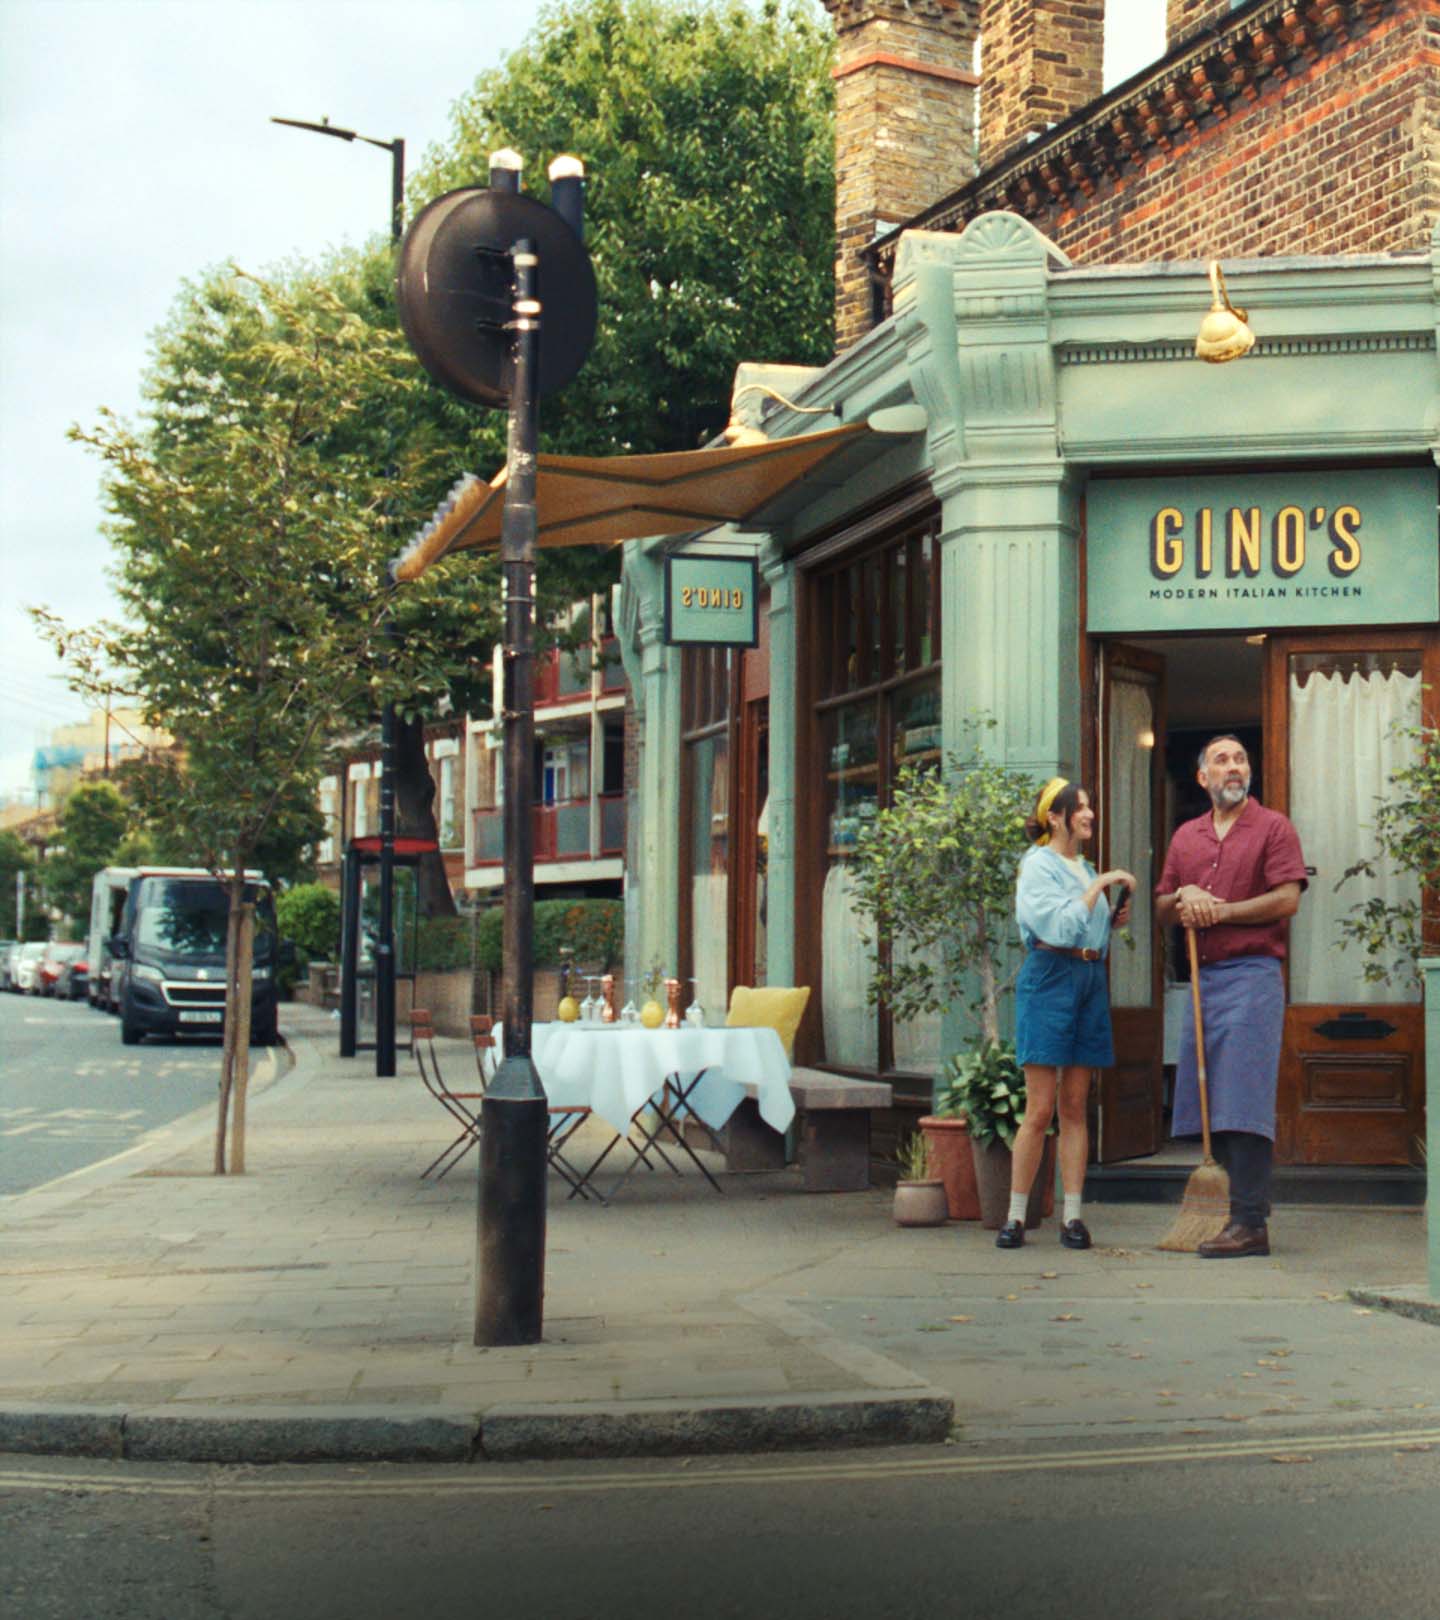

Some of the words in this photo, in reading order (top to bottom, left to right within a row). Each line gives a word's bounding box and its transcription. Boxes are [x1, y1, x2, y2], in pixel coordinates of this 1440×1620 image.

[1150, 504, 1362, 581] GINO'S
[1150, 588, 1218, 600] MODERN
[1226, 587, 1287, 599] ITALIAN
[1295, 586, 1362, 598] KITCHEN
